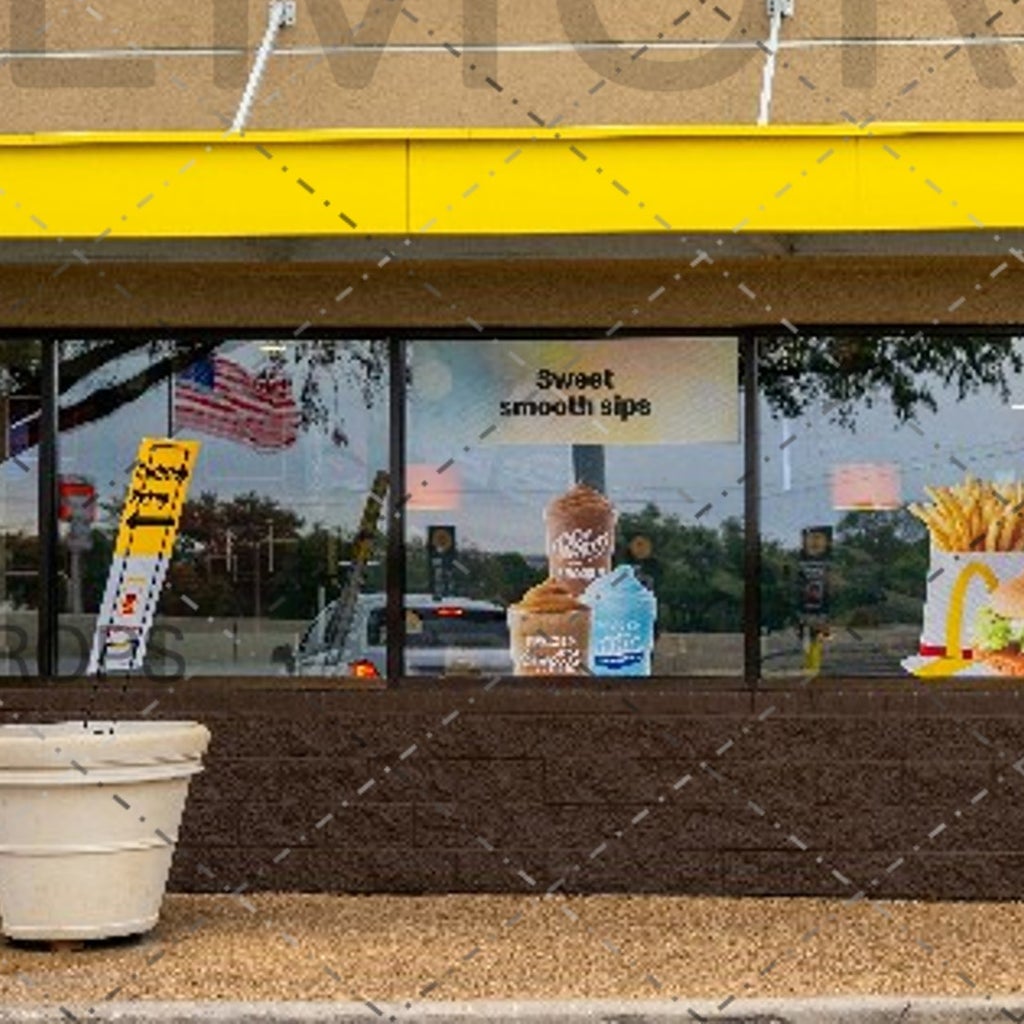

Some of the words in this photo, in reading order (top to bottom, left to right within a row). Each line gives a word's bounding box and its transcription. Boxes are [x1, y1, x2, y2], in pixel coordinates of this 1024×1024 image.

[536, 369, 615, 389] Sweet
[500, 395, 594, 416] smooth
[601, 395, 652, 421] sips
